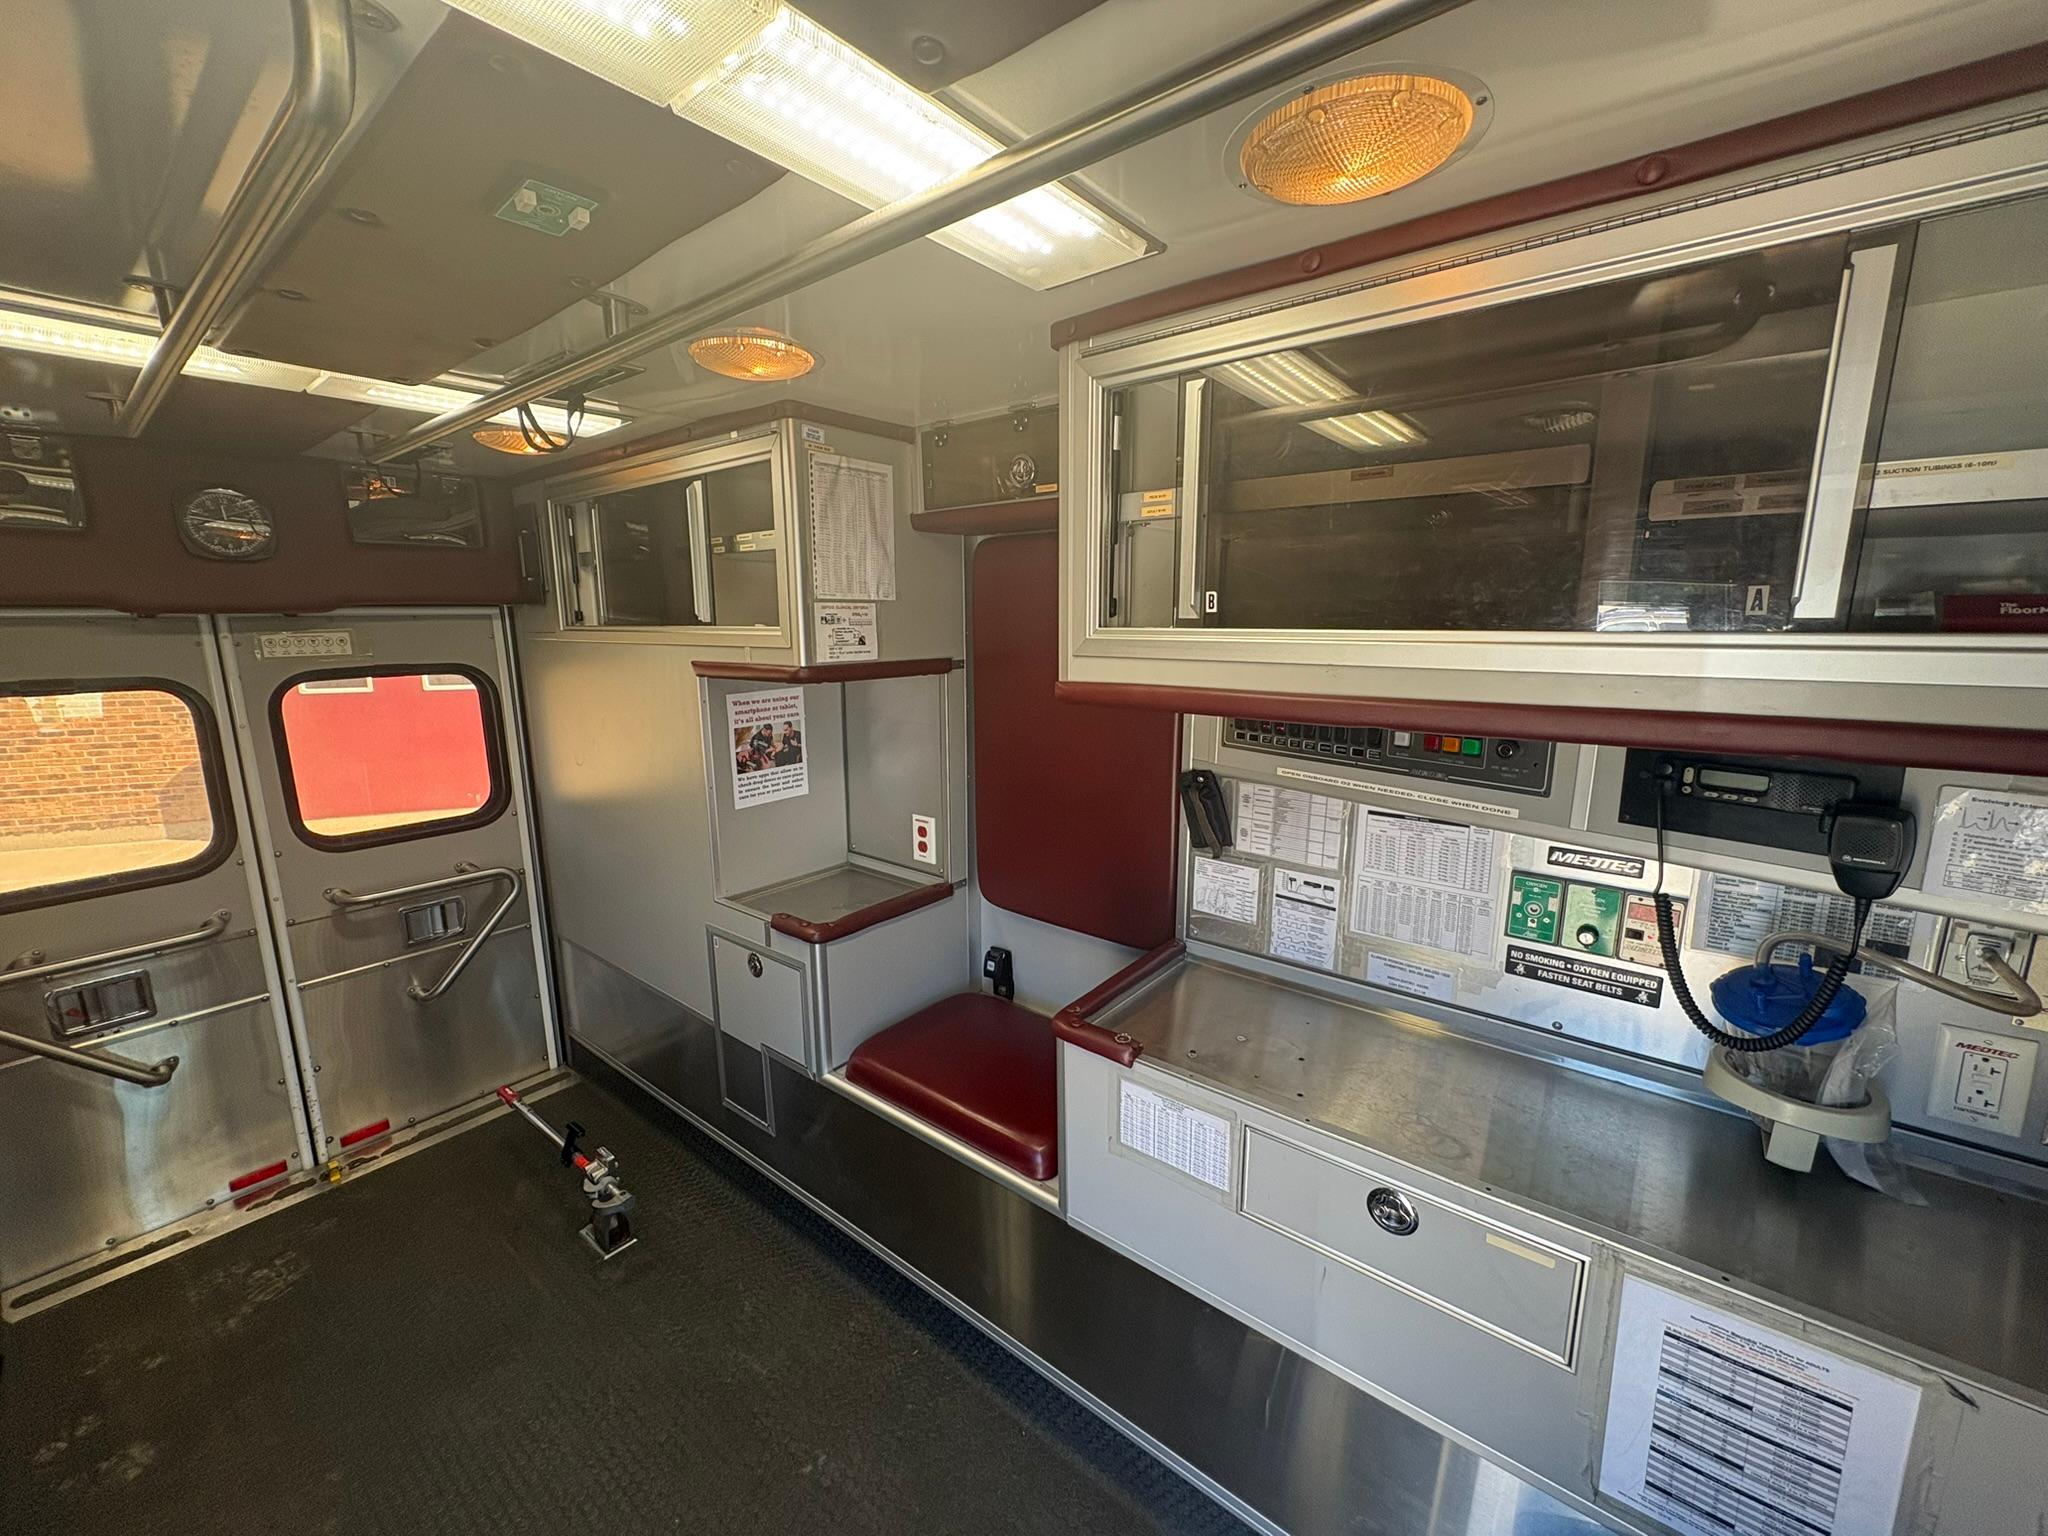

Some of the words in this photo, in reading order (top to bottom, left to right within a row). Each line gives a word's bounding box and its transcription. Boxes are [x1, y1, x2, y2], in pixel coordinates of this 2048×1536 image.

[1883, 466, 1921, 475] SUCTION
[1923, 462, 1962, 472] TUBINGS
[1208, 593, 1216, 610] B
[1750, 588, 1763, 611] A
[735, 706, 771, 715] smartphone
[1281, 770, 1301, 778] OPEN
[1302, 773, 1340, 785] ONBOARD
[1352, 782, 1376, 791] WHEN
[1417, 794, 1449, 804] CLOSE
[1451, 800, 1479, 810] WHEN
[1481, 806, 1511, 815] DONE
[1549, 850, 1643, 875] MEDTEC
[1525, 881, 1548, 889] OXYGEN
[1510, 950, 1524, 961] NO
[1524, 952, 1565, 969] SMOKING
[1573, 963, 1611, 980] OXYGEN
[1611, 972, 1658, 989] EQUIPPED
[1537, 970, 1571, 984] FASTEN
[1571, 978, 1593, 989] SEAT
[1595, 982, 1623, 996] BELTS
[1955, 1042, 2020, 1060] MEDTEC
